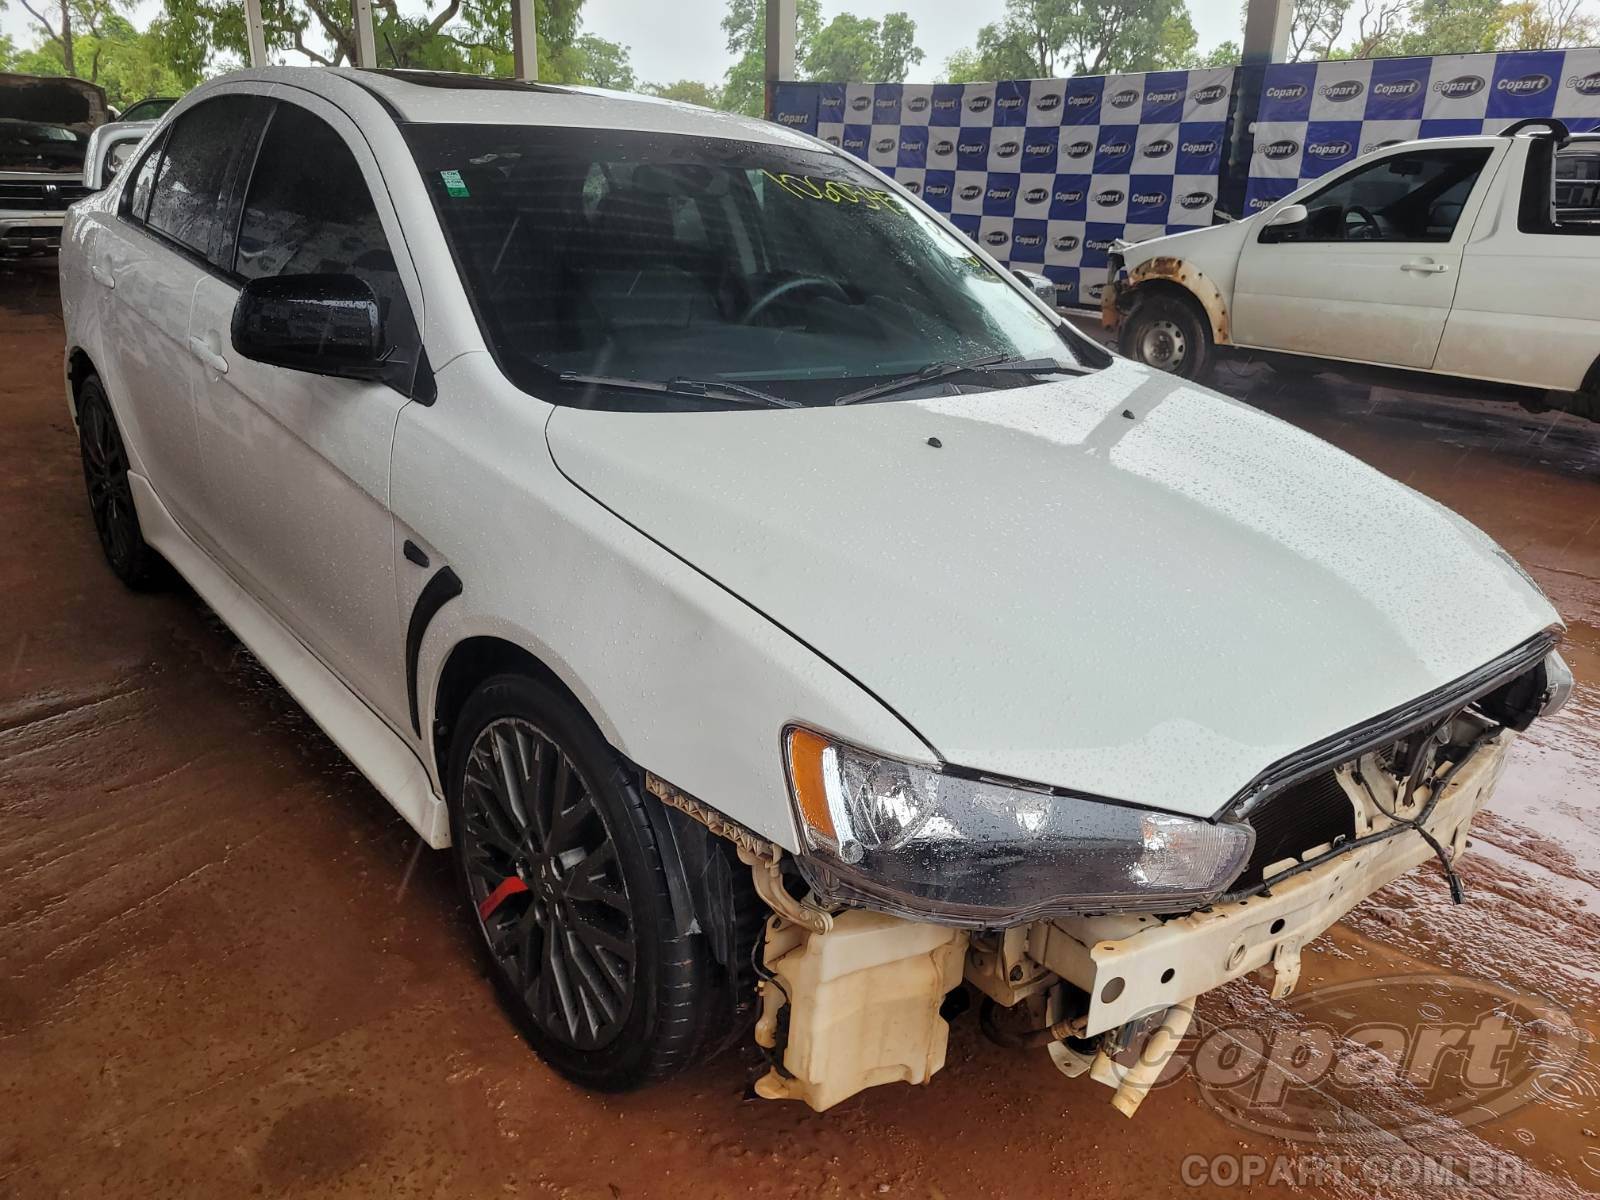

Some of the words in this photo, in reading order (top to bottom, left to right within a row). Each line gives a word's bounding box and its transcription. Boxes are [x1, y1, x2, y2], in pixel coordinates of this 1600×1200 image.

[1374, 80, 1416, 96] Copart
[1432, 78, 1478, 96] Copart
[1497, 77, 1545, 93] Copart
[1565, 75, 1600, 92] Copa
[1266, 86, 1303, 101] Copart
[1318, 83, 1359, 98] Copart
[966, 97, 988, 110] opart
[997, 97, 1022, 108] Copart
[1030, 96, 1056, 108] opart
[1068, 94, 1096, 106] Copart
[1145, 91, 1178, 104] Copart
[777, 112, 809, 125] Copart
[959, 142, 984, 154] Copart
[994, 143, 1017, 156] opart
[1025, 143, 1051, 154] Copart
[1099, 143, 1127, 155] Copart
[1181, 141, 1214, 155] Copart
[1257, 142, 1294, 156] Copart
[1308, 142, 1348, 156] Copart
[987, 189, 1012, 201] Copart
[1022, 190, 1045, 203] opart
[1055, 191, 1081, 203] Copart
[1131, 192, 1163, 205] Copart
[1250, 198, 1272, 211] Copa
[1015, 234, 1041, 246] Copart
[1053, 237, 1077, 249] opart
[1086, 240, 1111, 252] Copar
[1055, 282, 1073, 292] part
